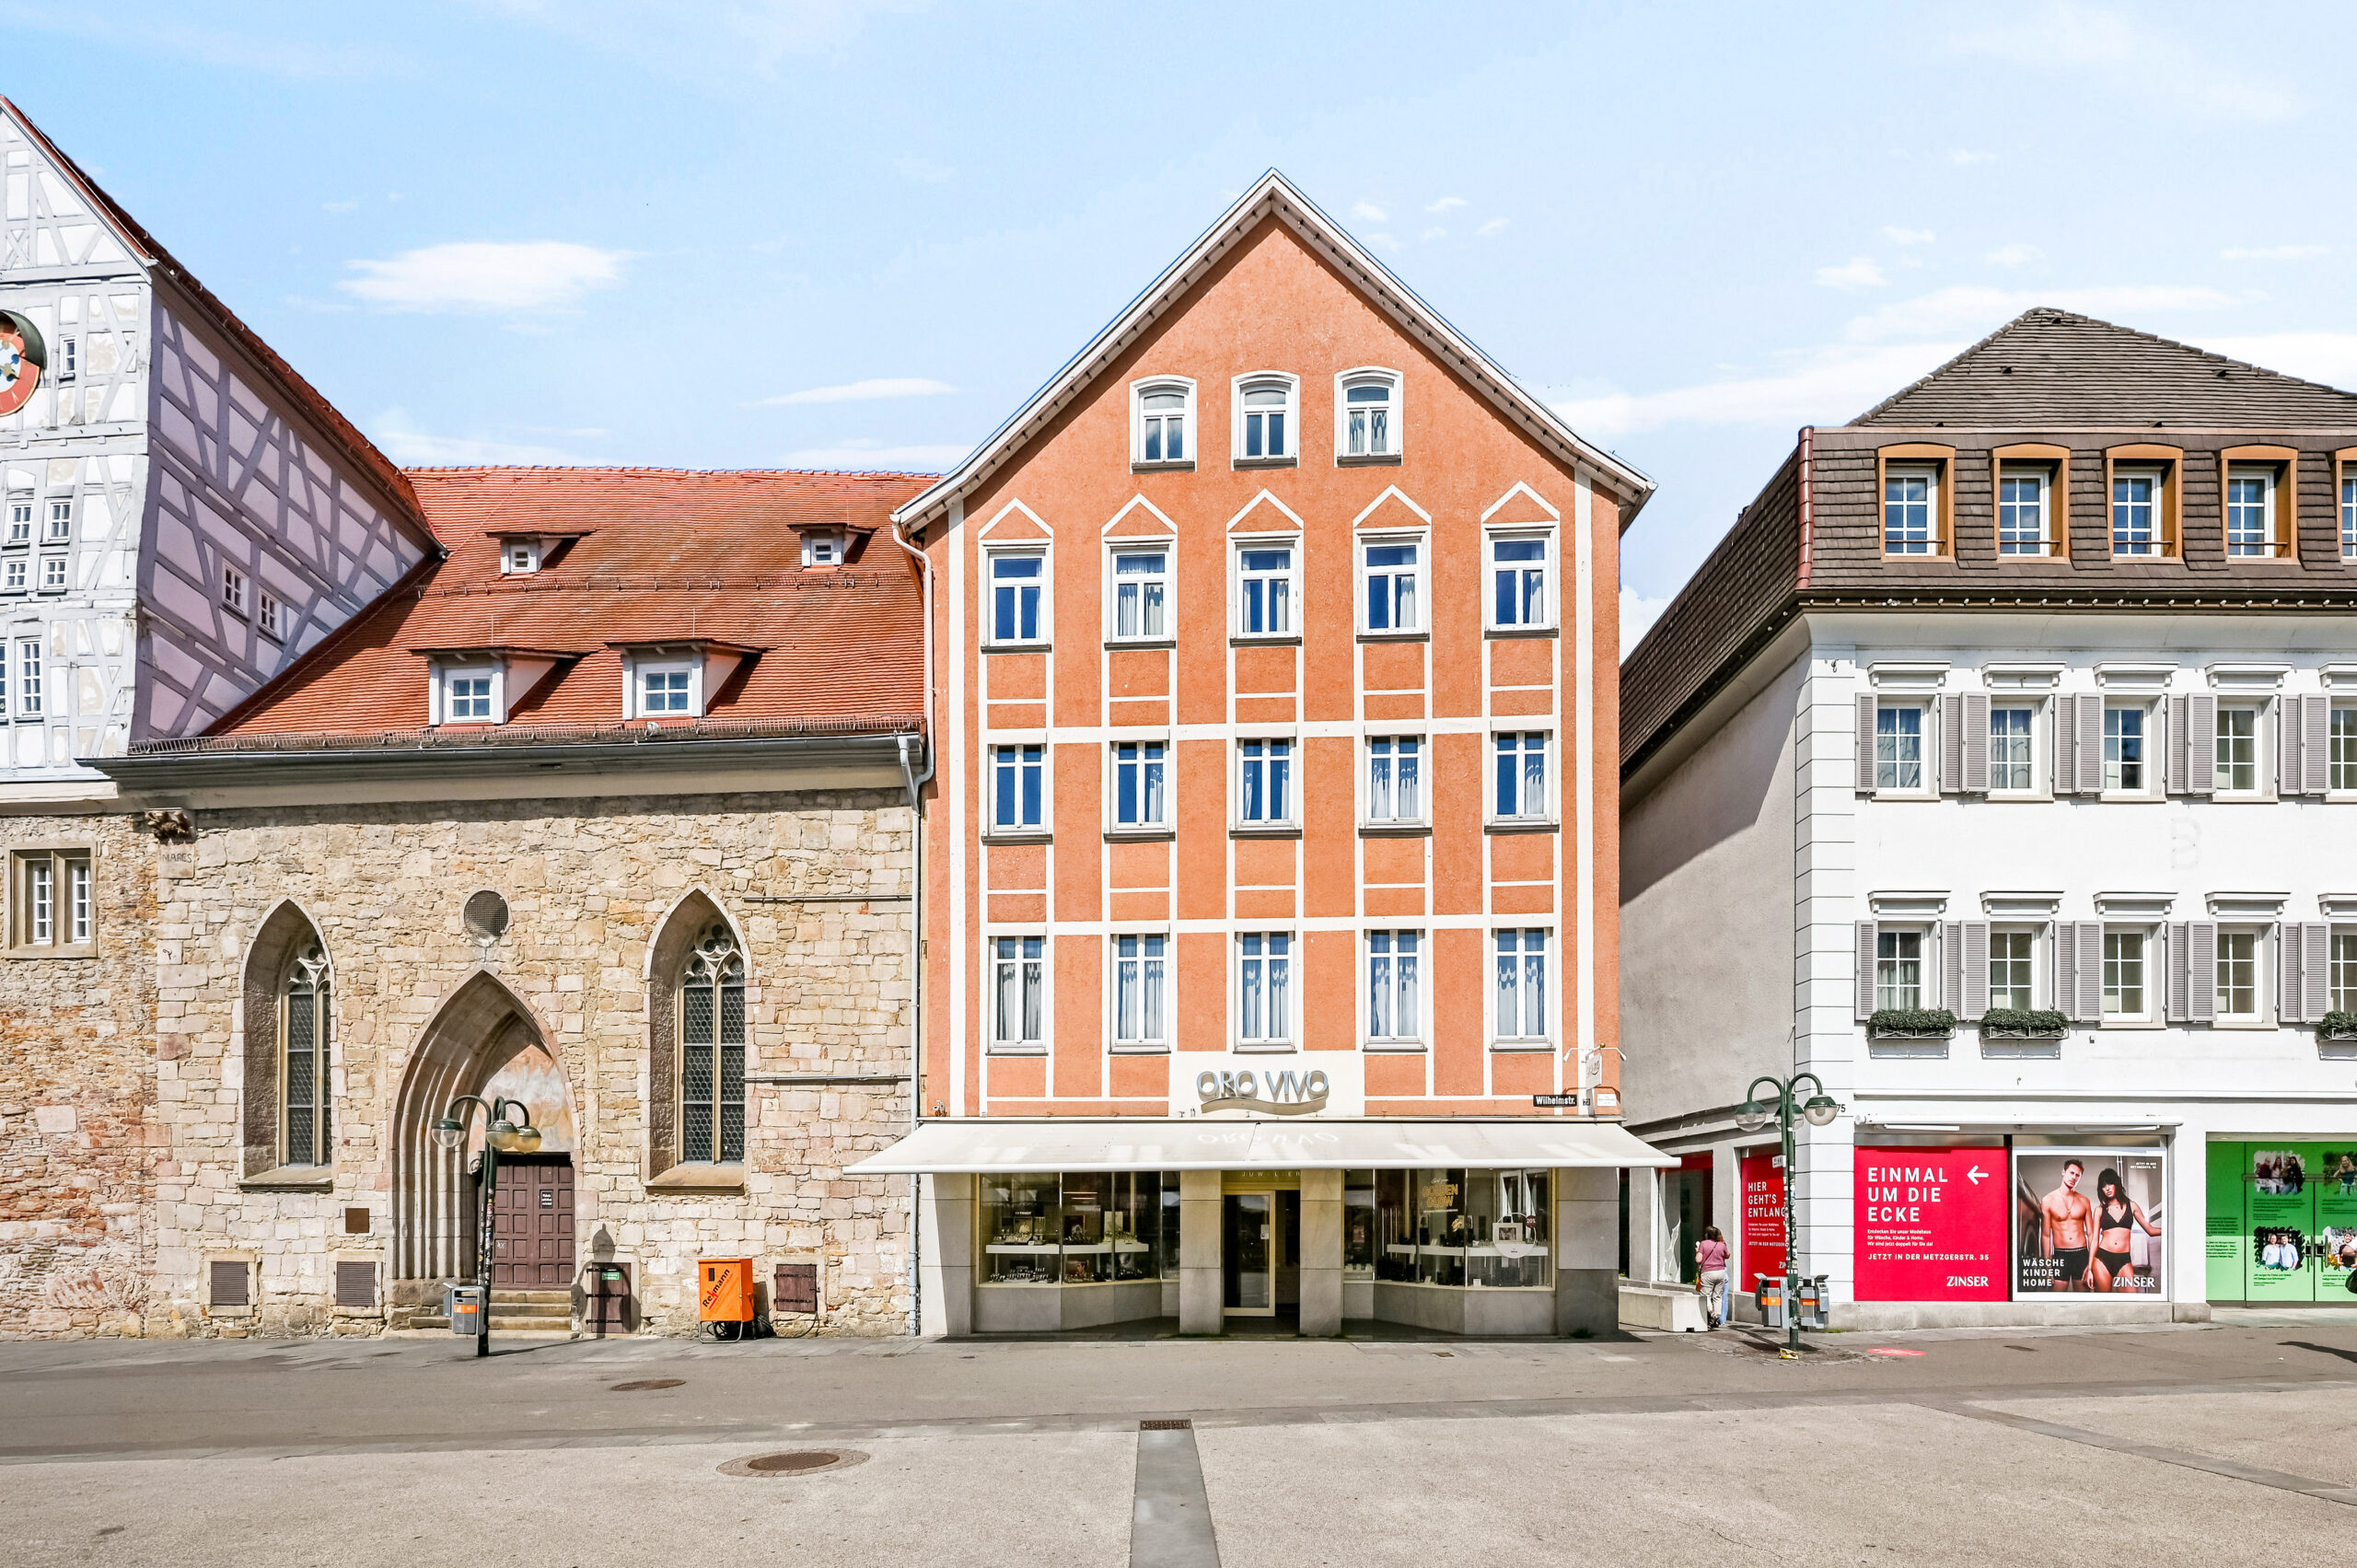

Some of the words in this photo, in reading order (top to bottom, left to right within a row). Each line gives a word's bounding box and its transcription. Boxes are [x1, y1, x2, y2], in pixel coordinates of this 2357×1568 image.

[1197, 1070, 1258, 1102] ORO
[1265, 1070, 1329, 1103] VIVO
[1536, 1096, 1575, 1105] Wilhelmstr.
[1868, 1167, 1948, 1182] EINMAL
[1747, 1181, 1767, 1192] HIER
[1747, 1194, 1777, 1205] GEHT'S
[1868, 1188, 1898, 1202] UM
[1908, 1188, 1941, 1202] DIE
[1868, 1207, 1920, 1222] ECKE
[2023, 1258, 2064, 1267] WÄSCHE
[2023, 1269, 2061, 1277] KINDER
[1946, 1276, 1989, 1286] ZINSER
[2023, 1279, 2052, 1287] HOME
[2113, 1277, 2155, 1287] ZINSER
